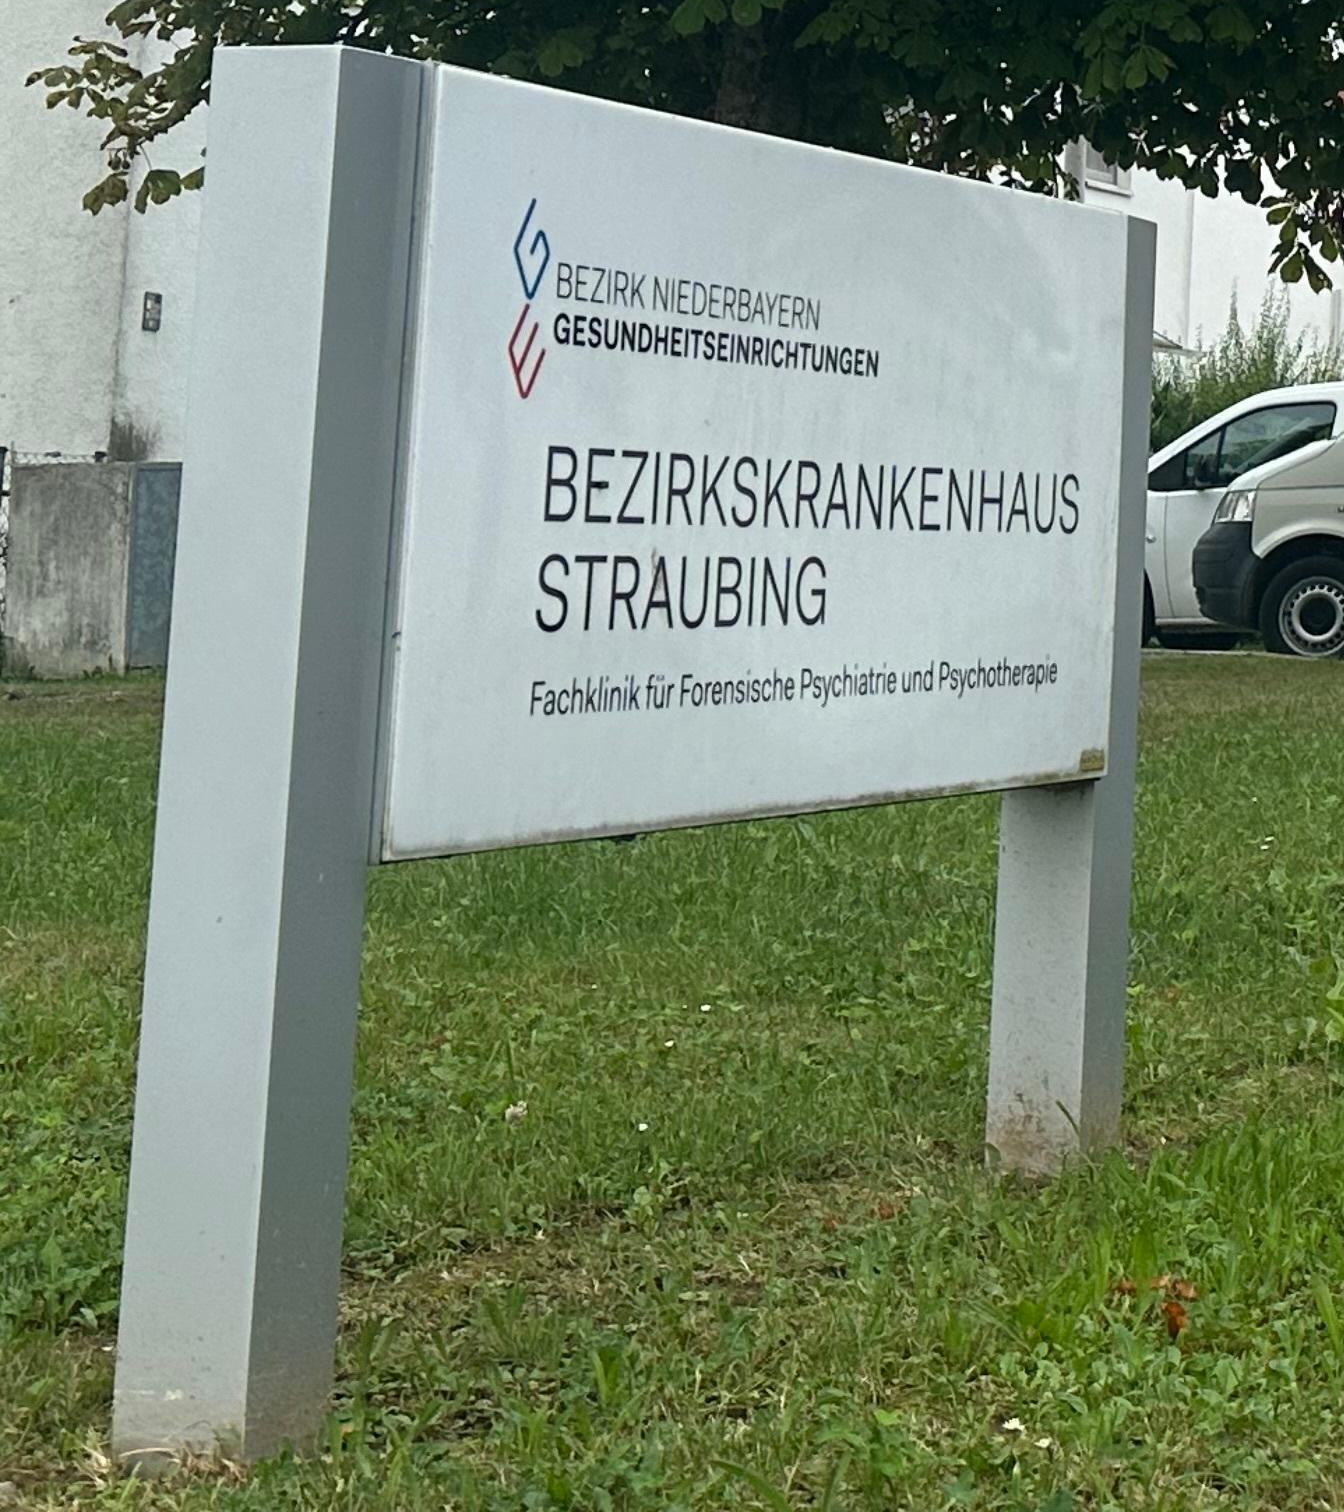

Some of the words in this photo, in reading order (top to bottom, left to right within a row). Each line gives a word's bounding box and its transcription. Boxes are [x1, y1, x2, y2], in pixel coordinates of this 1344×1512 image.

[556, 262, 647, 309] BEZIRK
[652, 275, 821, 332] NIEDERBAYERN
[553, 311, 880, 378] GESUNDHEITSEINRICHTUNGEN
[543, 445, 1081, 535] BEZIRKSKRANKENHAUS
[535, 552, 828, 633] STRAUBING
[529, 674, 641, 717] Fachklinik
[644, 673, 676, 710] für
[679, 668, 796, 708] Forensische
[799, 661, 898, 708] Psychiatrie
[902, 660, 935, 694] und
[938, 654, 1059, 699] Psychotherapie
